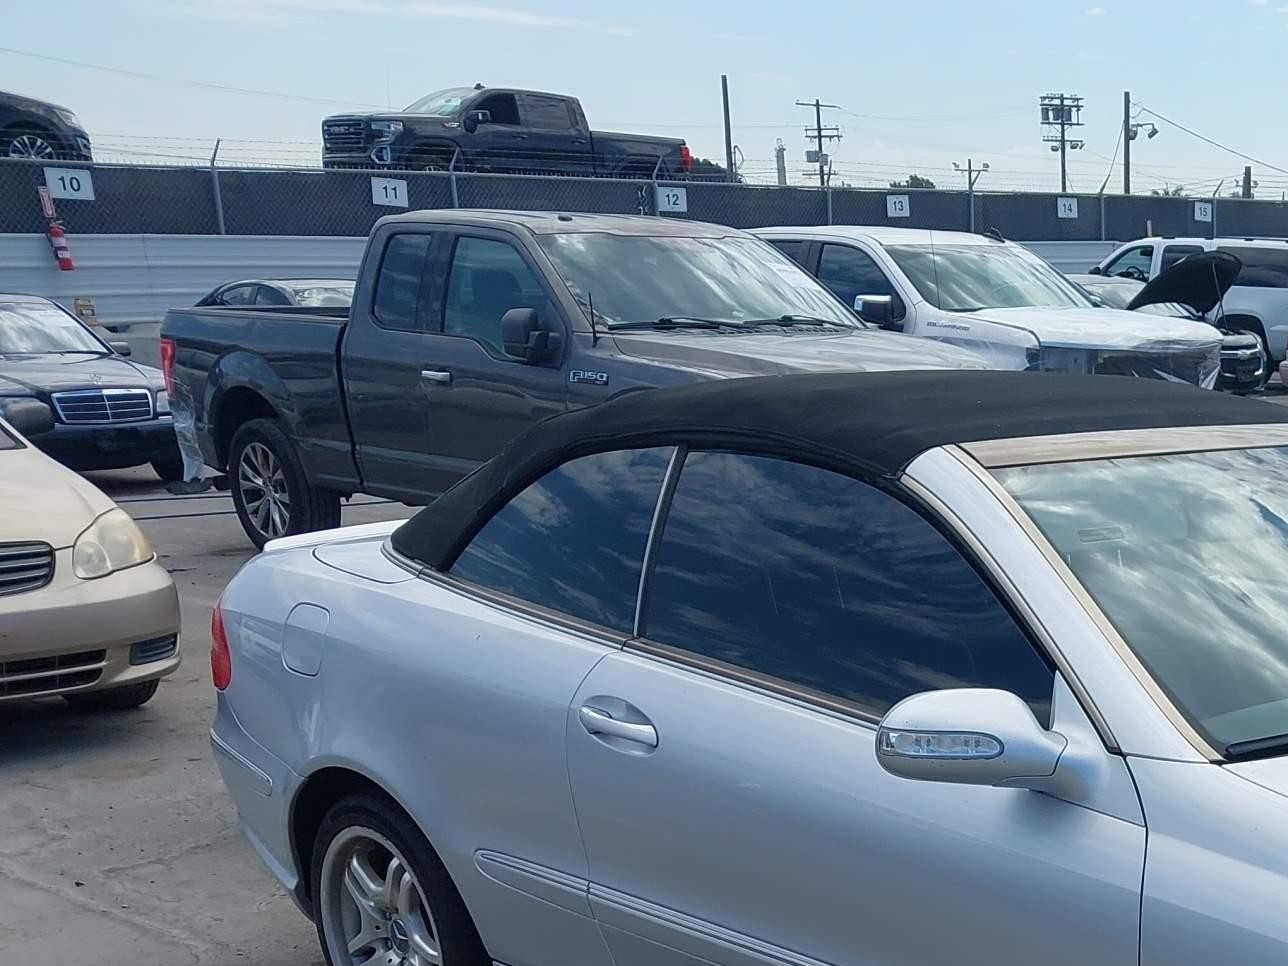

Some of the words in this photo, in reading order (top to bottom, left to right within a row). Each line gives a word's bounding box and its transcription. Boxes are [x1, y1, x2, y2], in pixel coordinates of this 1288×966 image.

[58, 175, 81, 192] 10
[382, 184, 398, 200] 11
[665, 193, 680, 206] 12
[893, 200, 904, 212] 13
[1062, 203, 1073, 214] 14
[1199, 207, 1208, 217] 15
